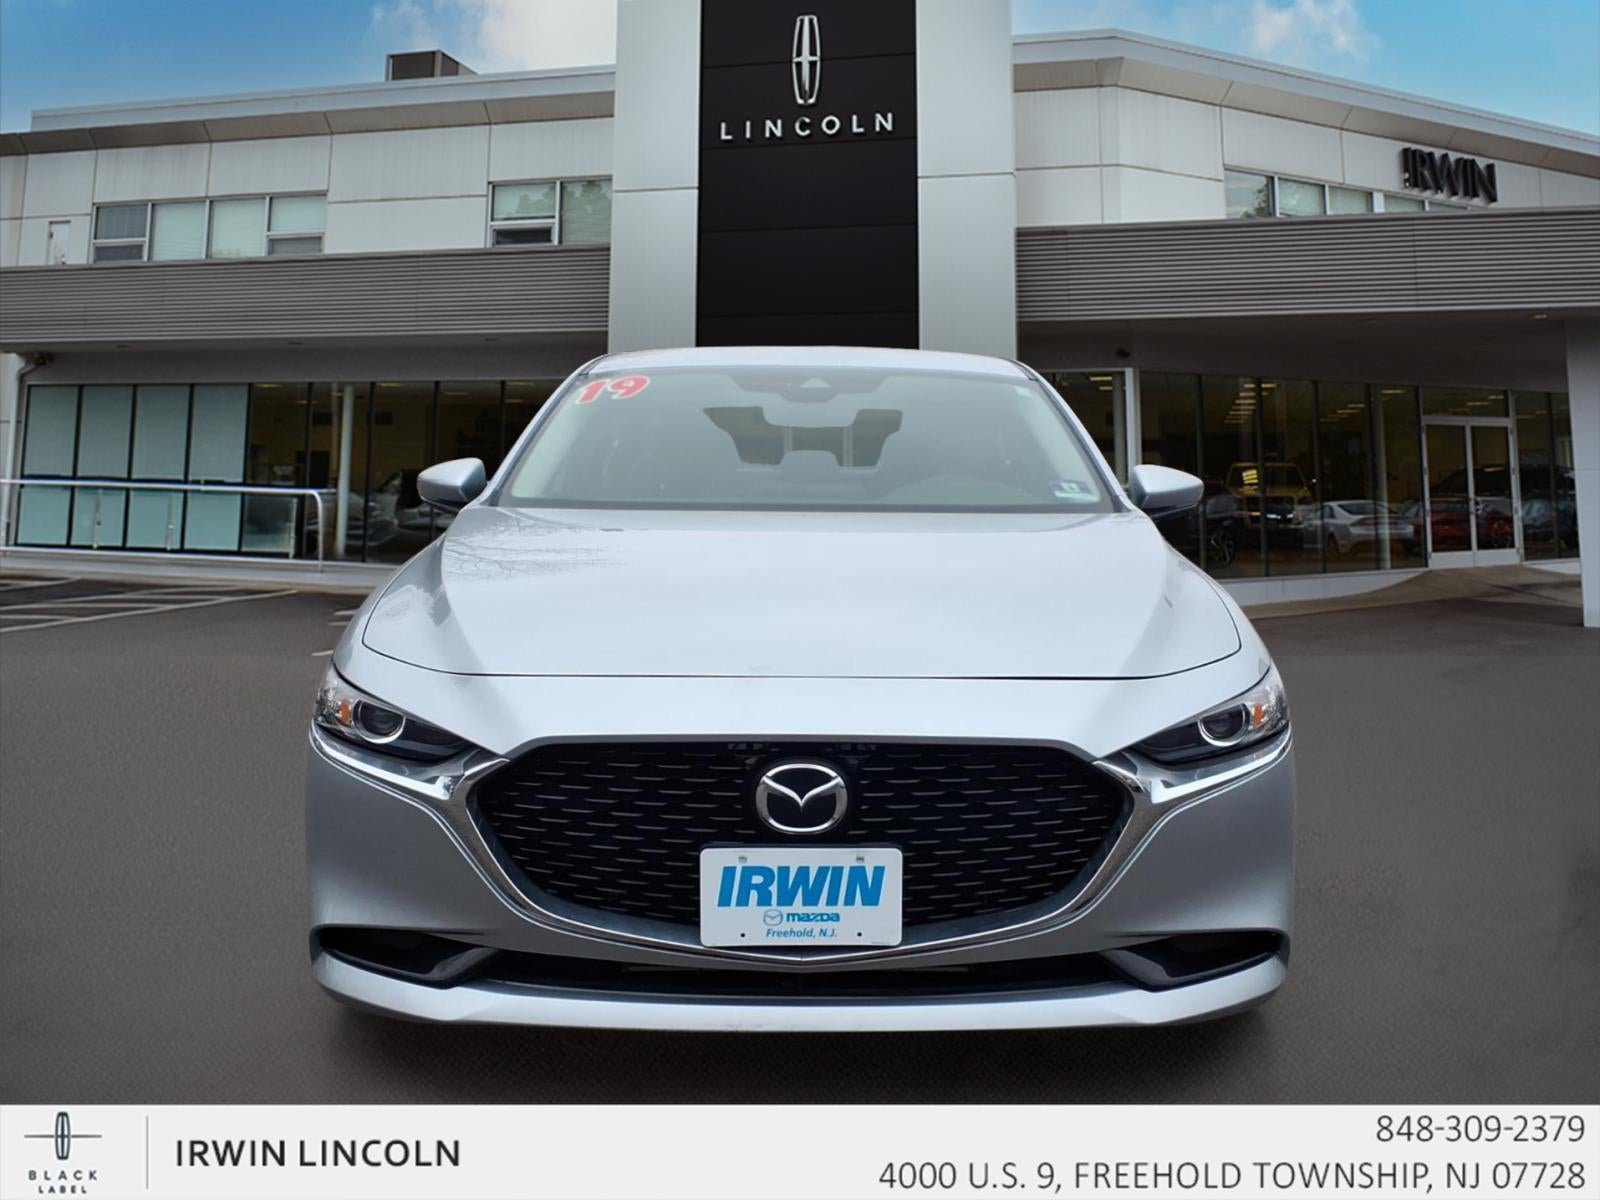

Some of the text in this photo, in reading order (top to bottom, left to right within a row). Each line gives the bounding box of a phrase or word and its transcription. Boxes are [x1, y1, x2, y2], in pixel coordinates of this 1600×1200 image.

[720, 112, 893, 140] LINCOLN
[1401, 147, 1498, 203] IRWIN
[575, 375, 650, 404] 19
[717, 865, 886, 907] IRWIN
[786, 912, 840, 922] mazda
[766, 928, 837, 939] Freehold, N.J.
